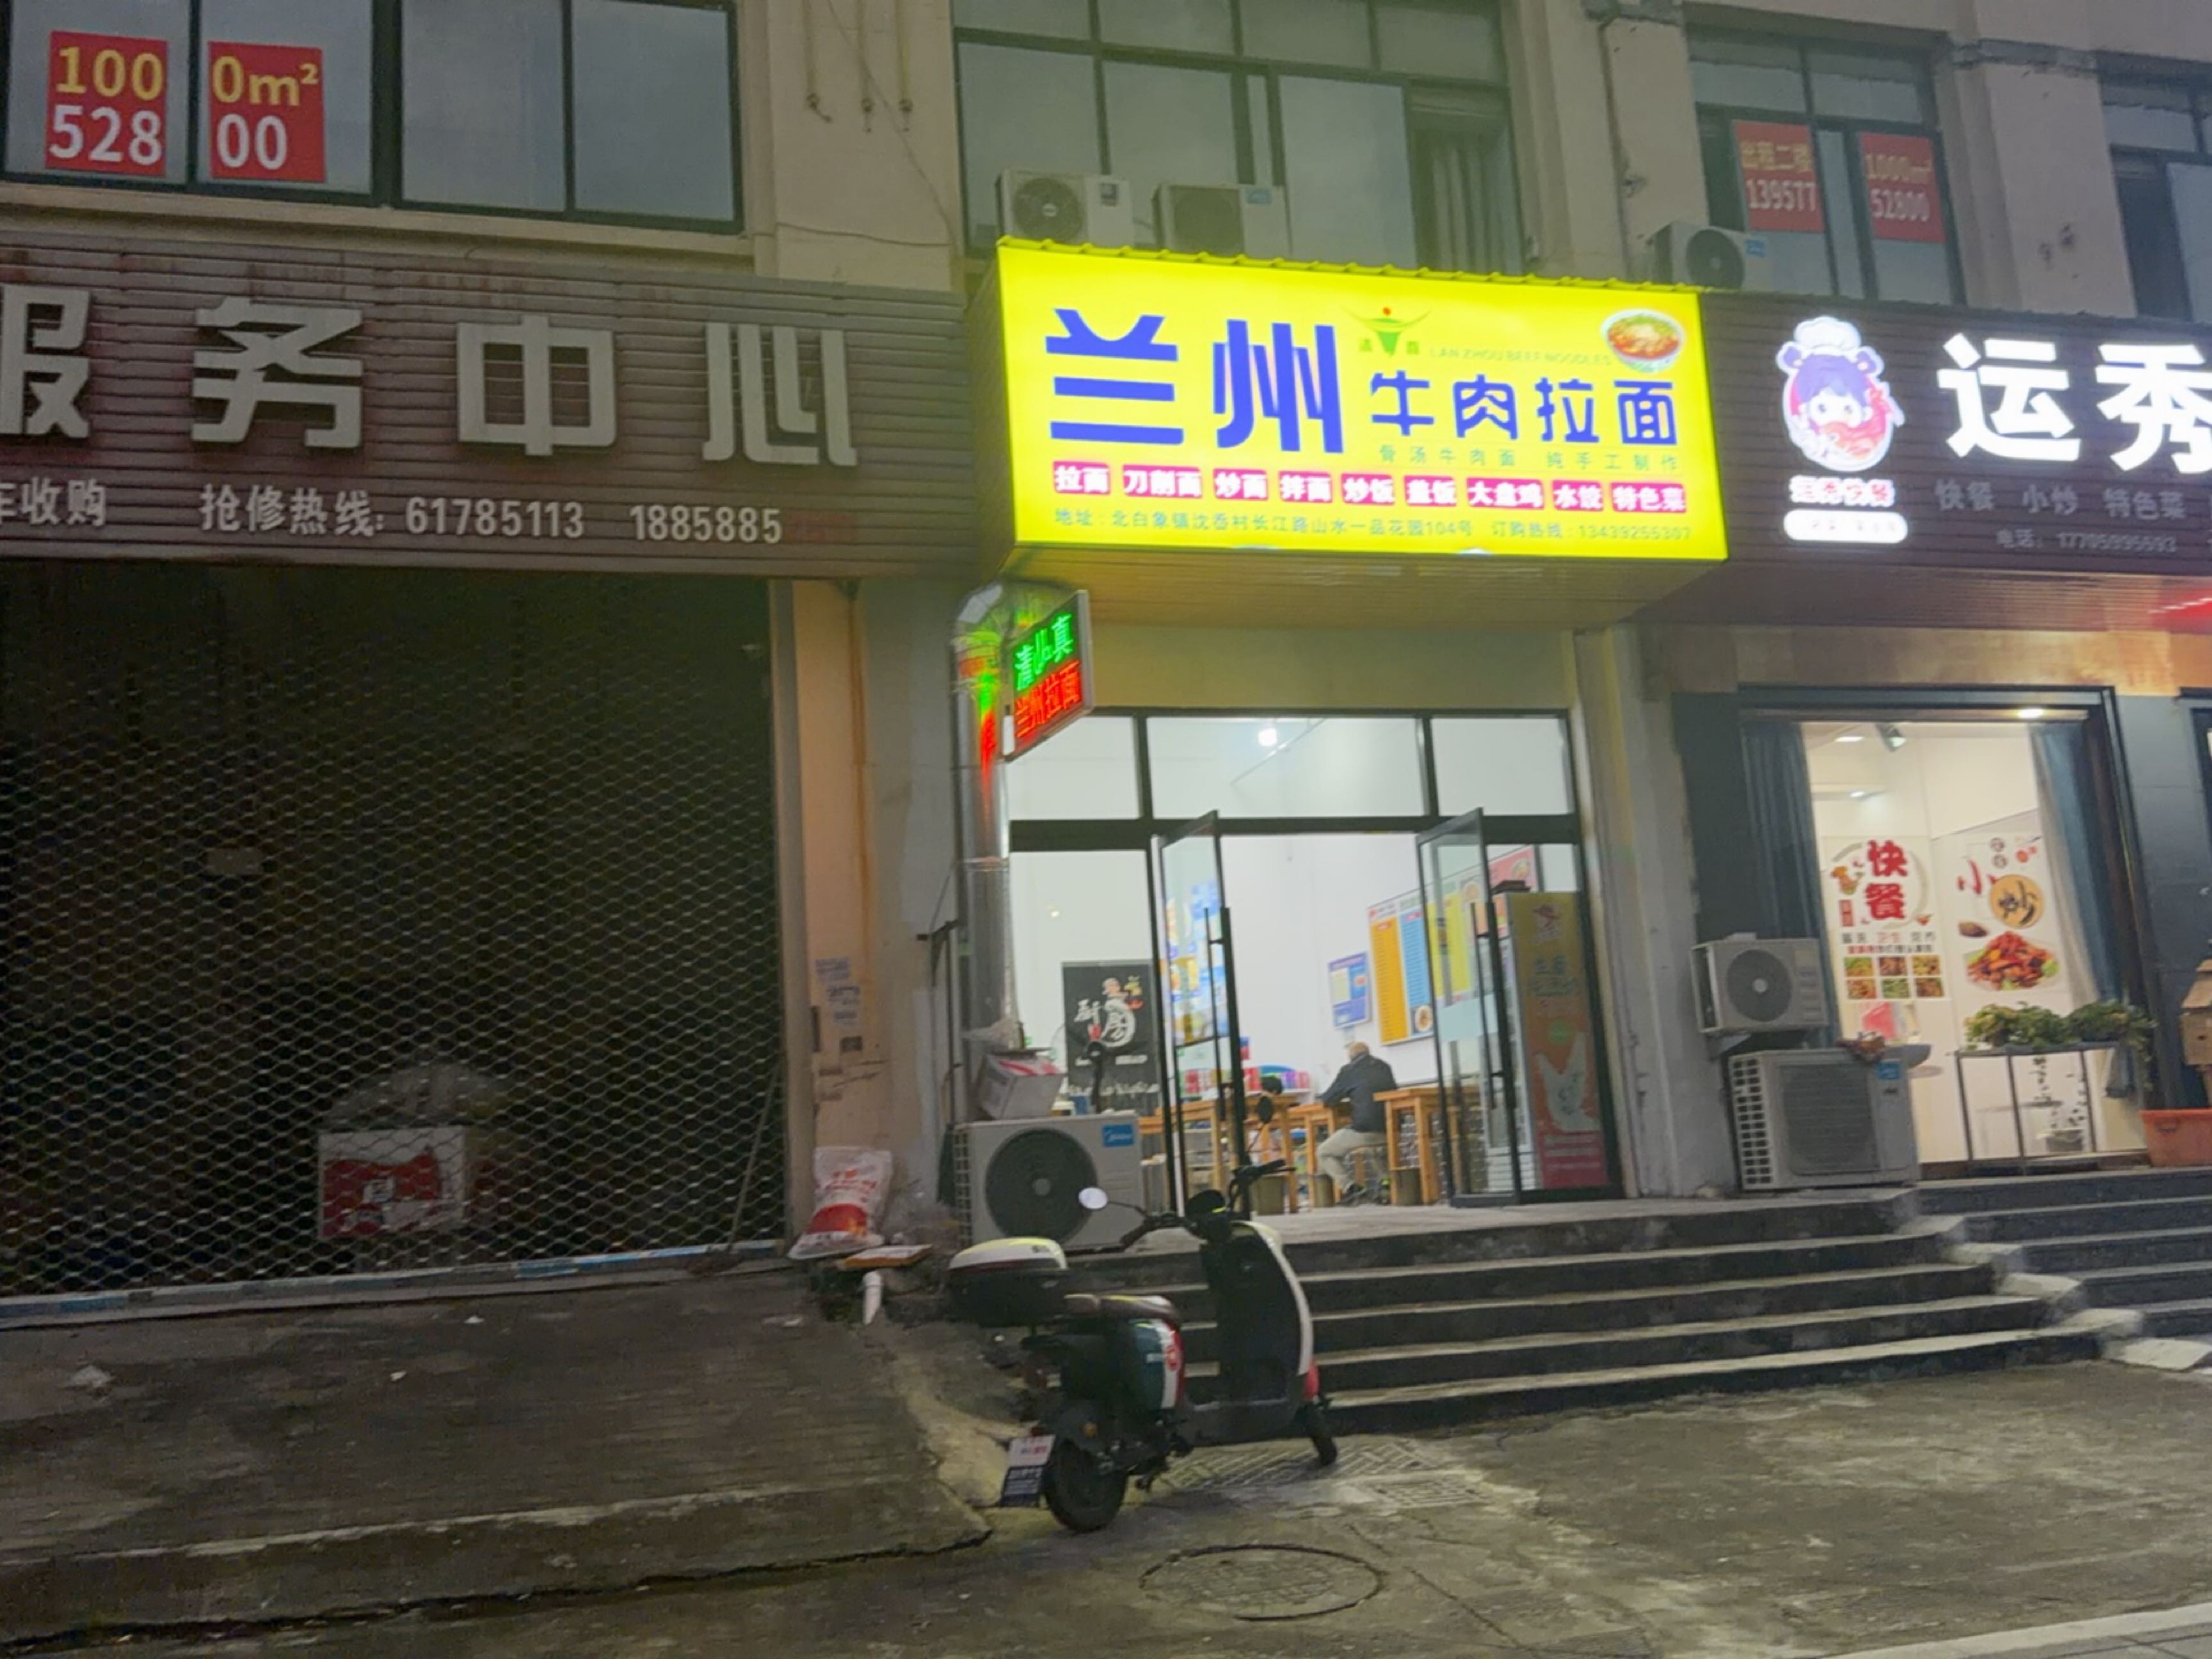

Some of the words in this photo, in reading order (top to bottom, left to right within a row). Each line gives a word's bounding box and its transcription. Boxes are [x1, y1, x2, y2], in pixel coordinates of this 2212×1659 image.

[56, 46, 164, 101] 100
[49, 104, 163, 166] 528
[216, 113, 288, 170] 00
[0, 284, 858, 466] 服务中心
[1045, 308, 1344, 453] 兰州
[1370, 370, 1678, 445] 牛肉拉面
[1937, 332, 2212, 474] 运秀
[405, 495, 584, 539] 61785113
[629, 504, 782, 545] 1885885
[1054, 465, 1109, 494] 拉面
[1123, 469, 1202, 497] 刀削面
[1215, 471, 1267, 499] 炒面
[1343, 477, 1394, 504] 炒饭
[1555, 485, 1603, 509] 水饺
[1612, 486, 1686, 511] 特色菜
[1864, 839, 1909, 921] 快餐
